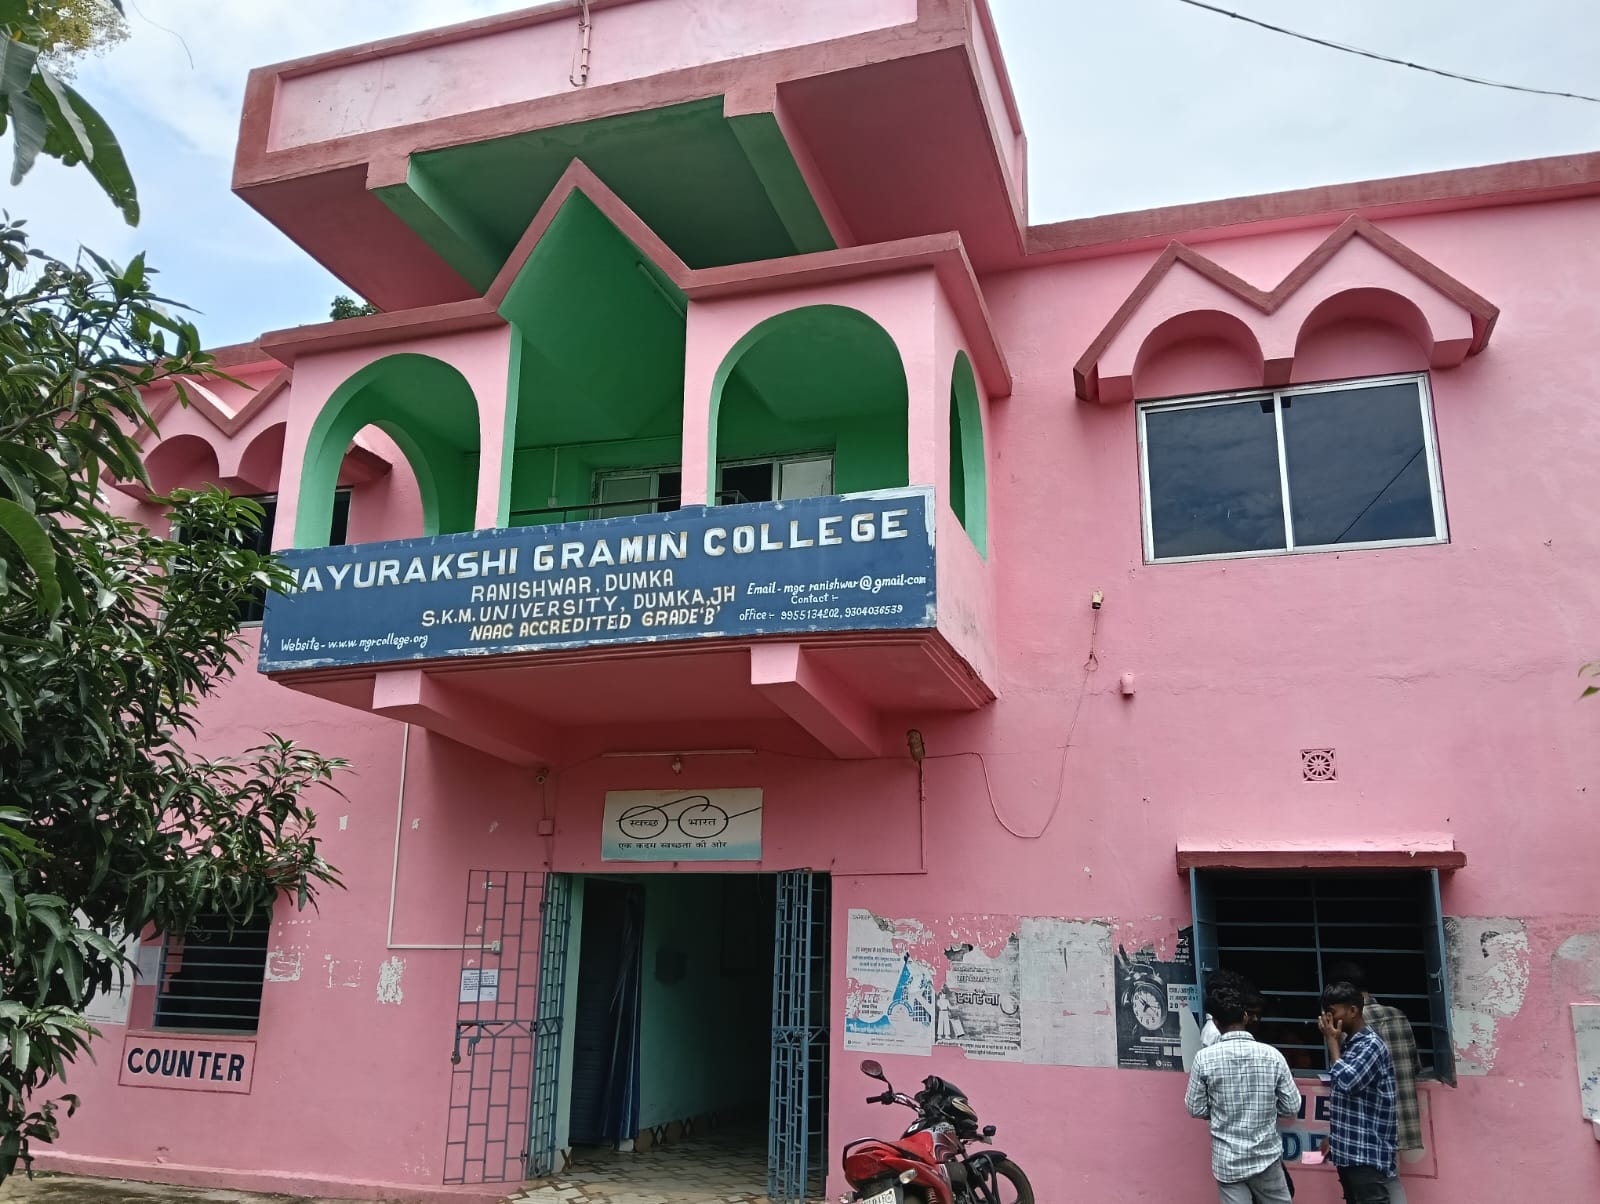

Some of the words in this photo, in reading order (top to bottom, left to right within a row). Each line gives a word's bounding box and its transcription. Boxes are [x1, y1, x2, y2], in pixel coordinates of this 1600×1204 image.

[533, 530, 688, 572] GRAMIN
[703, 508, 909, 557] COLLEGE
[470, 576, 600, 603] RANISHWAR,
[605, 568, 674, 592] DUMKA
[808, 574, 927, 594] ranishwar@gmail.com
[469, 623, 514, 641] NAAC
[519, 614, 631, 637] ACCREDITED
[630, 819, 659, 828] स्वच्छ
[688, 817, 717, 827] भारत
[618, 842, 632, 851] एक
[636, 841, 656, 850] कदम
[660, 841, 692, 850] स्वच्छता
[695, 840, 707, 849] की
[711, 839, 728, 849] ओर
[127, 1047, 245, 1082] COUNTER
